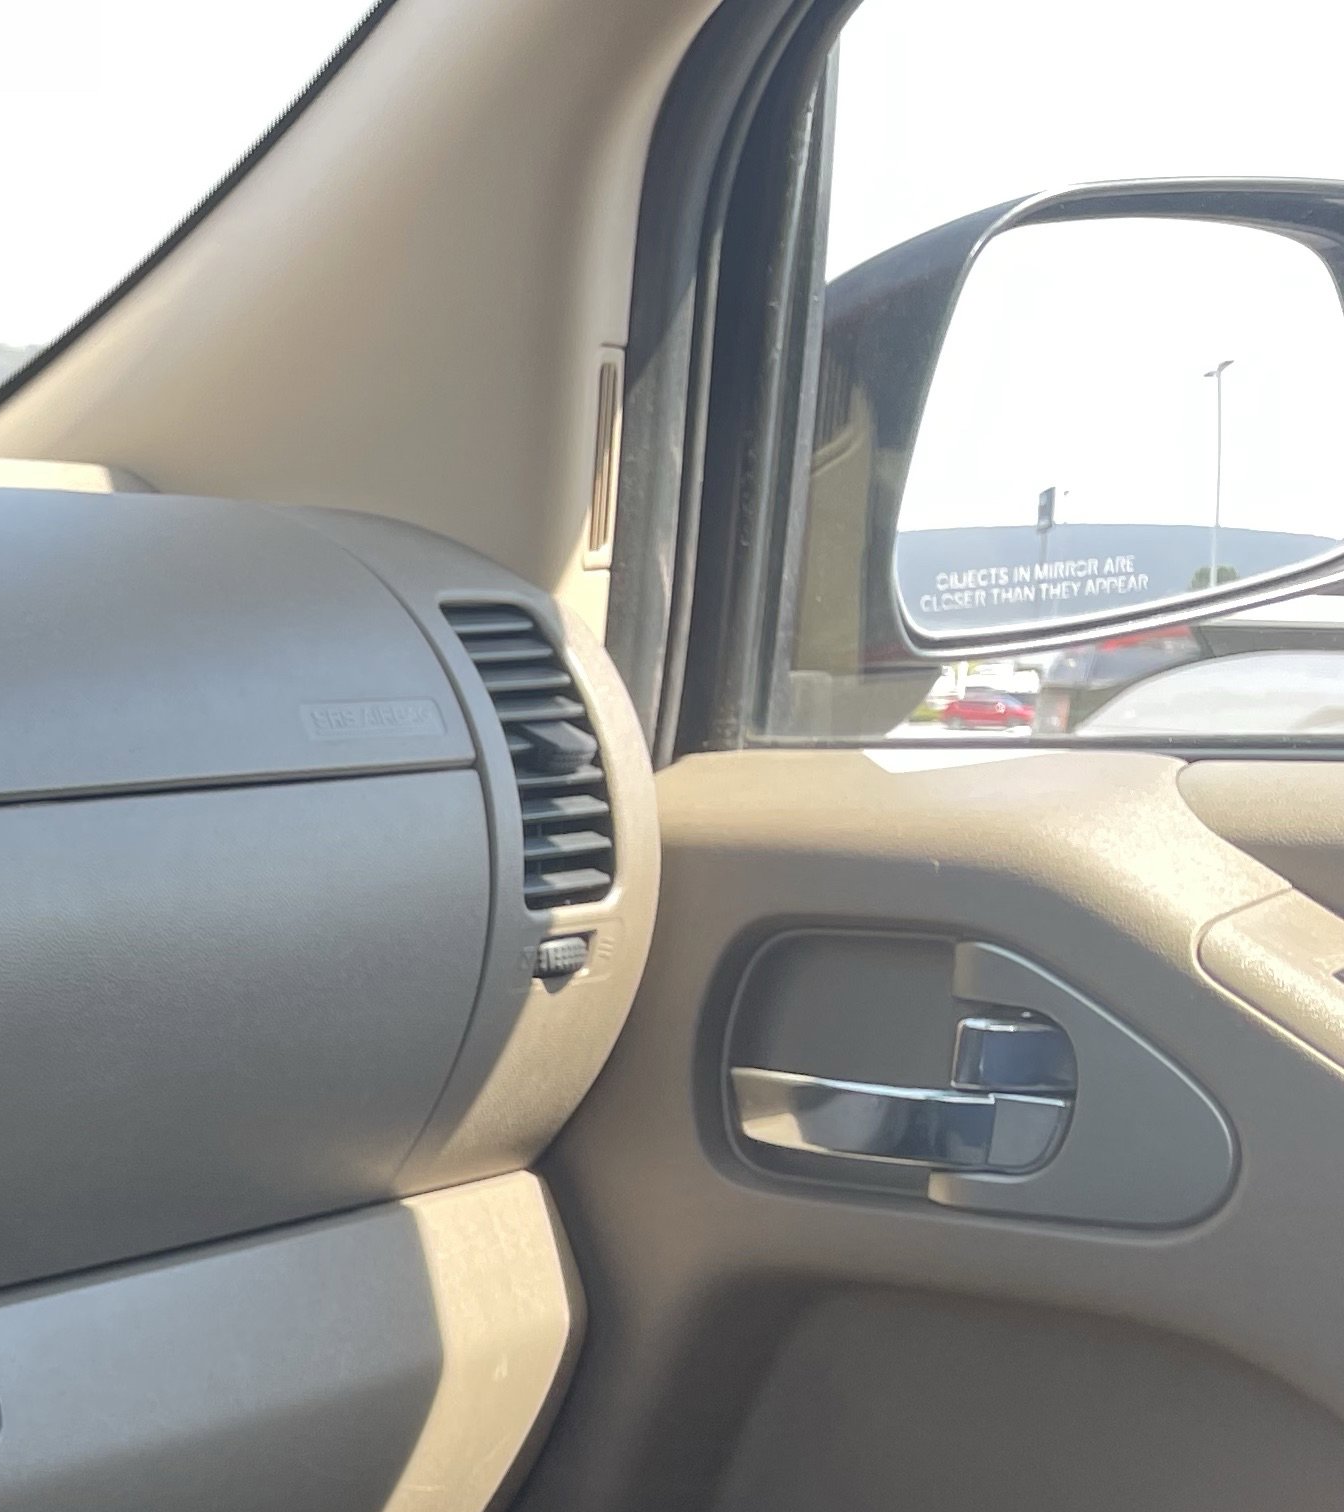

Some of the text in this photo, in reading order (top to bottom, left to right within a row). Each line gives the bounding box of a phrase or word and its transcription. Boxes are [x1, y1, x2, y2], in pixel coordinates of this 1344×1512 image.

[1013, 565, 1031, 583] IN
[1034, 558, 1098, 581] MIRROR
[1103, 554, 1136, 574] ARE
[920, 573, 1149, 613] CLOSER THAN THEY APPEAR
